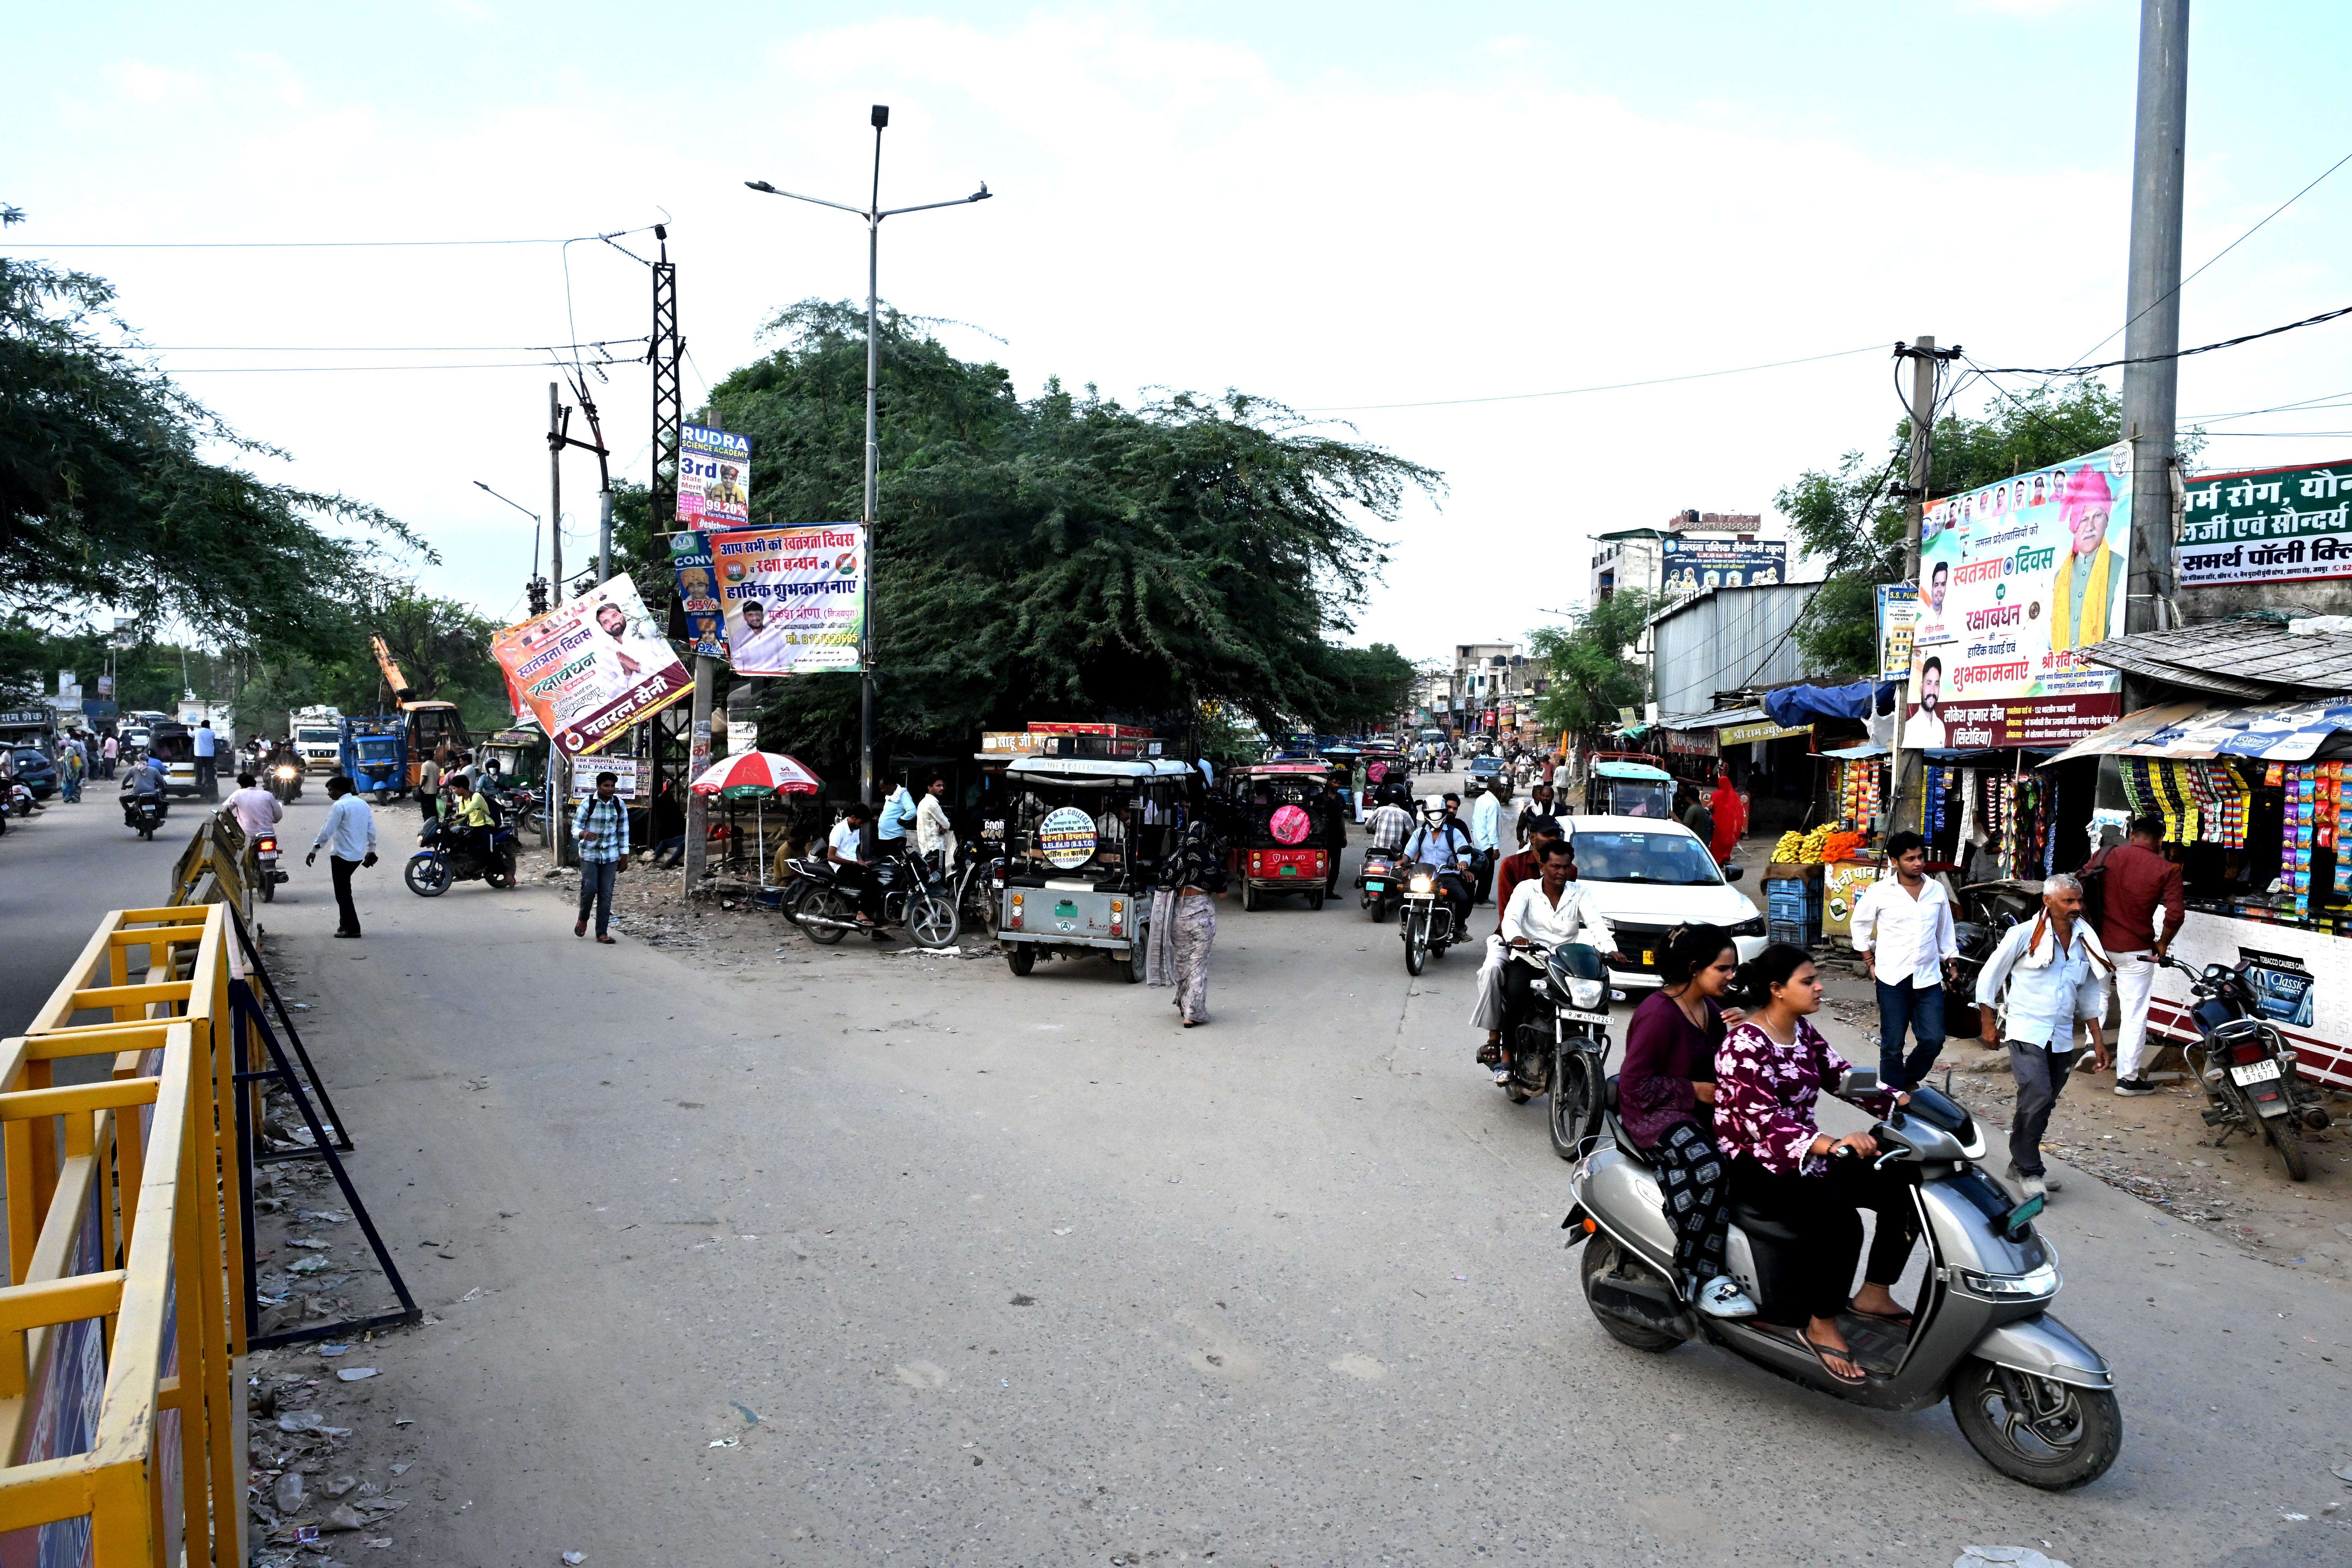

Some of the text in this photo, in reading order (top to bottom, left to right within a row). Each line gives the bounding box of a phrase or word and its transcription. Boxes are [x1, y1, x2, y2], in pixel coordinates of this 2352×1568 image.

[682, 426, 749, 452] RUDRA
[682, 440, 712, 452] SCIENCE
[714, 446, 748, 458] ACADEMY
[681, 458, 717, 479] 3rd
[681, 482, 702, 491] Merit
[682, 474, 702, 483] State
[2226, 478, 2291, 507] रोग,
[693, 506, 703, 514] 114
[706, 499, 747, 516] 99.20%
[2232, 510, 2268, 537] एवं
[2271, 501, 2349, 535] सौन्दर्य
[721, 531, 854, 555] आप सभी को स्वतंत्रता दिवस
[1976, 523, 2039, 549] समस्त प्रदेशवासियों को
[1678, 543, 1704, 551] कल्पना
[1705, 541, 1731, 552] पब्लिक
[1765, 545, 1785, 556] स्कूल
[2182, 545, 2244, 571] समर्थ
[2248, 539, 2306, 568] पॉली
[755, 559, 781, 572] रक्षा
[783, 556, 818, 571] बन्धन
[821, 560, 830, 569] की
[1953, 546, 2056, 586] स्वतंत्रता दिवस
[2248, 570, 2261, 579] पुरानी
[725, 575, 858, 602] हार्दिक शुभकामनाएं
[1997, 588, 2005, 597] एवं
[686, 599, 716, 611] 93%
[768, 605, 858, 623] मुकेश मीणा (विजयपुरा)
[1966, 600, 2022, 632] रक्षाबंधन
[786, 633, 800, 645] मो.
[1989, 632, 1995, 641] की
[516, 627, 593, 678] स्वतंत्रता दिवस
[698, 642, 722, 654] 92%
[1968, 638, 2016, 658] हार्दिक बधाई एवं
[2042, 651, 2054, 669] श्री
[2056, 650, 2071, 668] रवि
[527, 652, 597, 700] रक्षाबंधन
[1953, 656, 2030, 692] शुभकामनाएं
[572, 687, 586, 698] बधाई
[554, 686, 606, 727] शुभकामनाएं
[582, 698, 636, 735] नवरत्न
[634, 675, 669, 704] सैनी
[1944, 704, 2006, 726] लोकेश कुमार सैन
[1733, 725, 1783, 740] श्री राम ज्यूस
[1953, 727, 1993, 748] (सिरोहिया)
[996, 735, 1017, 752] साहू
[1018, 732, 1031, 748] जी
[1067, 809, 1090, 825] COLLEGE
[985, 821, 1004, 831] GOOD
[1041, 832, 1094, 842] वेटेनरी डिप्लोमा
[1071, 840, 1094, 849] (B.S.T.C)
[1046, 850, 1062, 858] नर्सिंग
[1071, 848, 1090, 857] फार्मेसी
[1853, 866, 1878, 880] पान
[2259, 956, 2278, 966] TOBACCO
[2279, 960, 2295, 970] CAUSES
[2271, 973, 2306, 990] Classic
[2245, 1069, 2273, 1083] R7677
